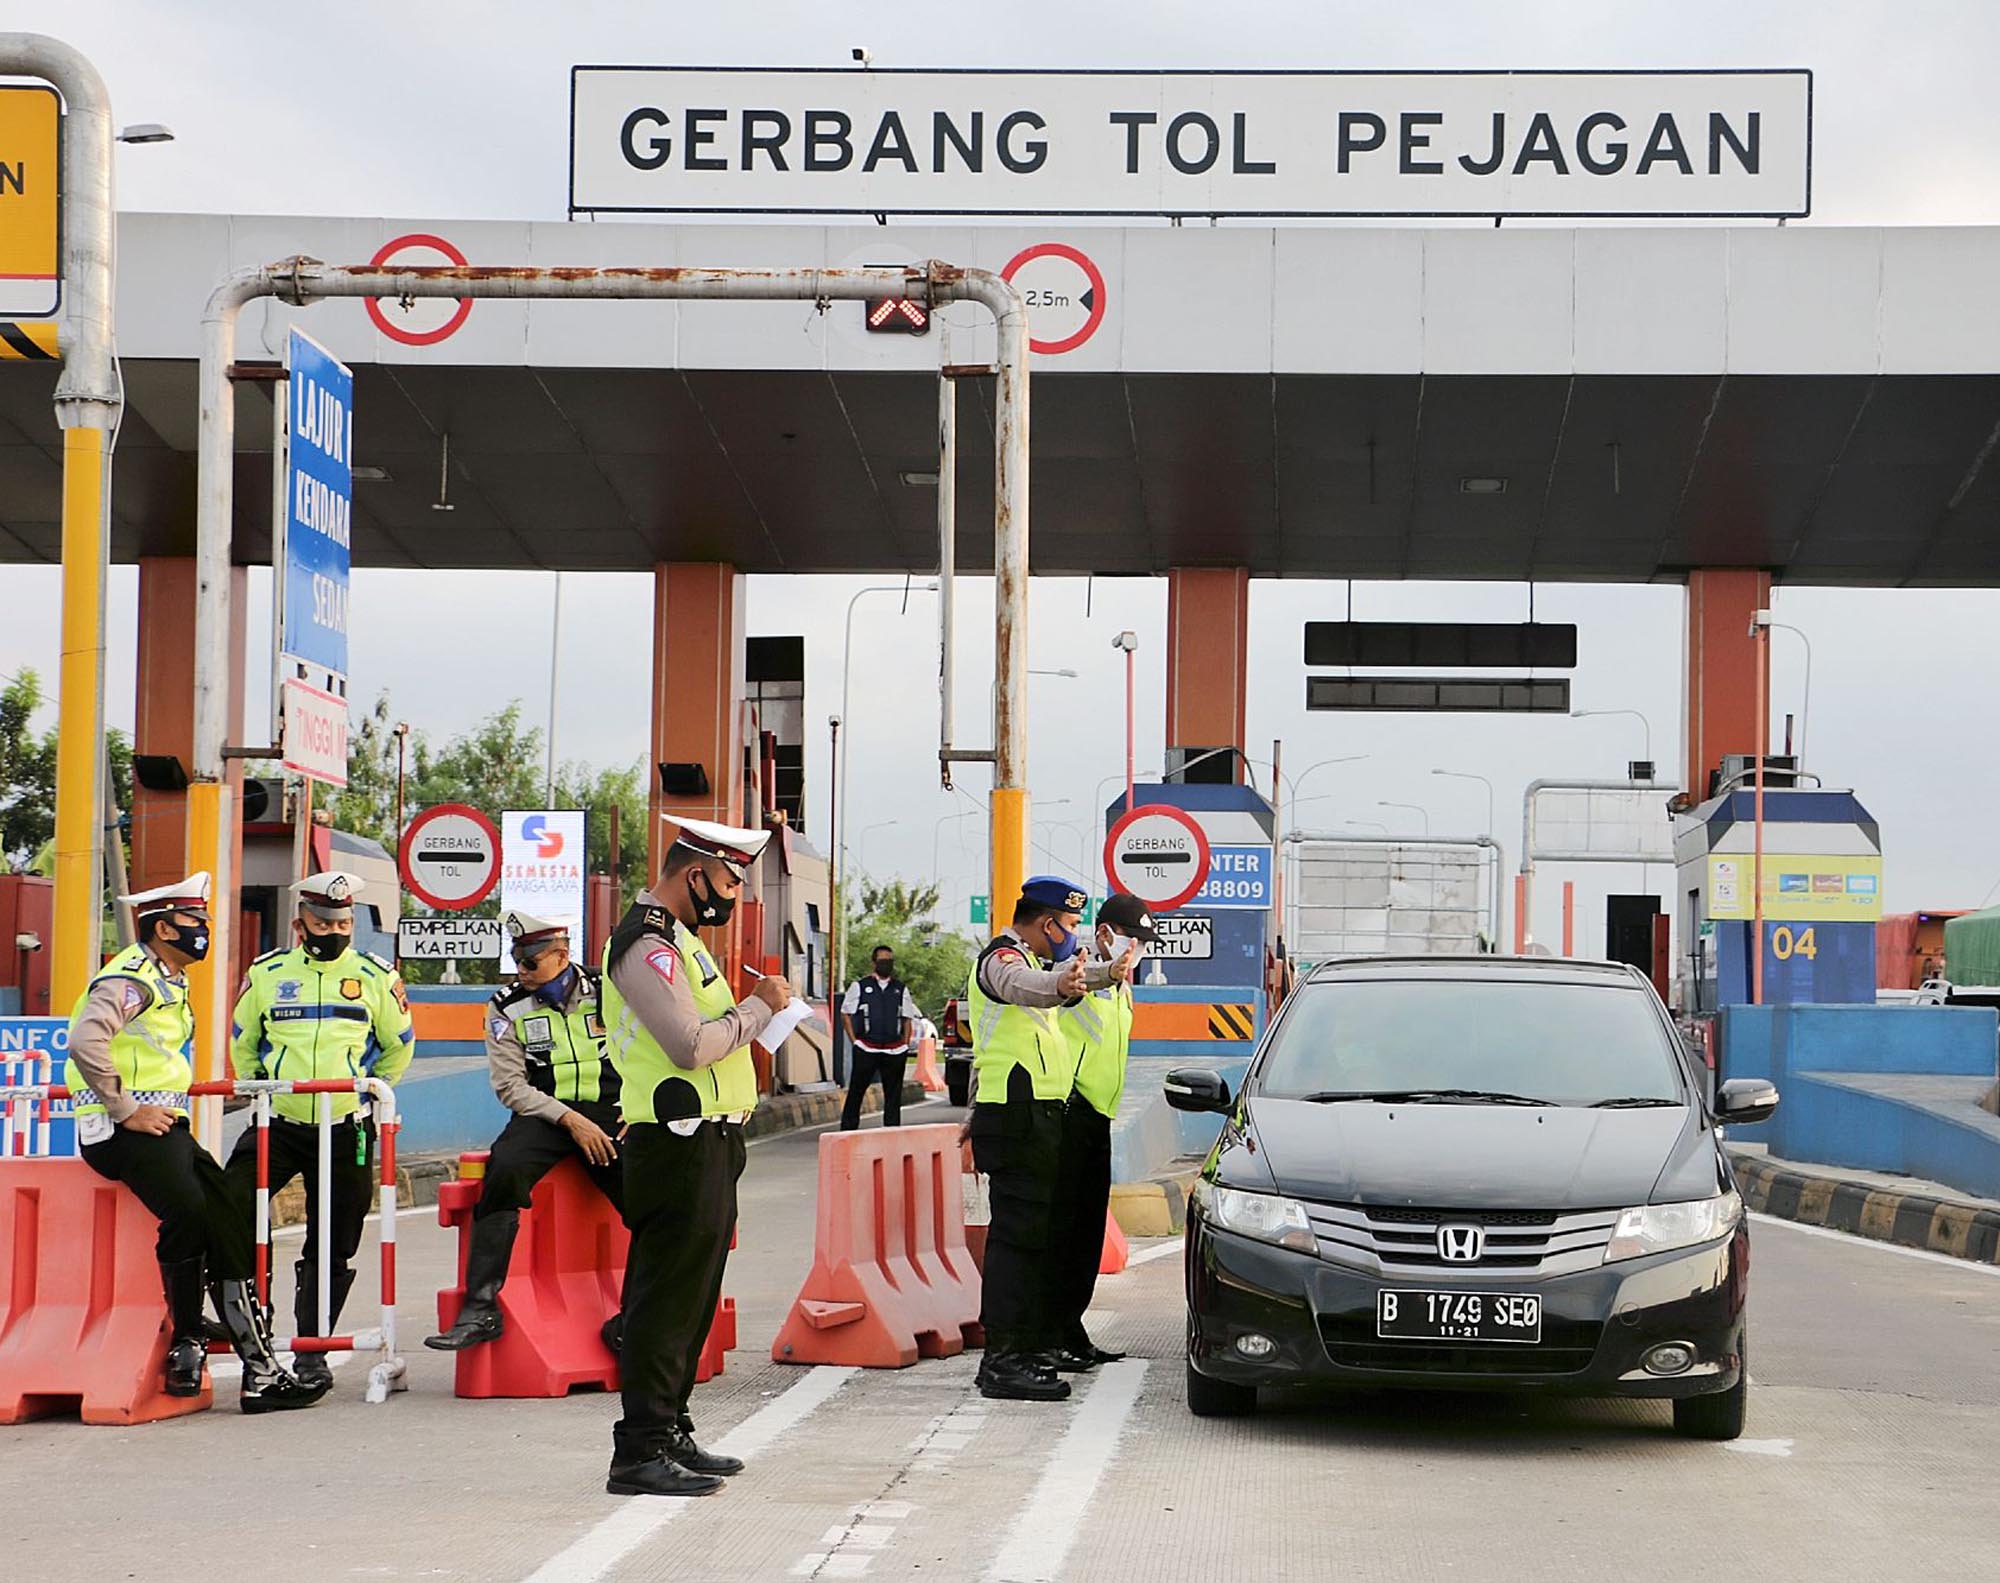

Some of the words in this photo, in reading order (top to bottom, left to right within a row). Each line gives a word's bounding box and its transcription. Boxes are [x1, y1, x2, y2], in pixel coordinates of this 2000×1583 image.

[620, 107, 1048, 174] GERBANG
[1109, 111, 1276, 175] TOL
[1336, 111, 1761, 175] PEJAGAN
[1025, 290, 1069, 308] 2,5m
[297, 371, 343, 463] LAJUR
[296, 706, 333, 757] TINGGI
[424, 837, 481, 849] GERBANG
[1127, 838, 1185, 850] GERBANG
[440, 865, 461, 877] TOL
[505, 865, 578, 878] SEMESTA
[1145, 866, 1168, 878] TOL
[401, 921, 500, 936] TEMPELKAN
[415, 941, 482, 955] KARTU
[1772, 926, 1817, 960] 04
[1383, 1293, 1398, 1321] B
[1426, 1294, 1481, 1323] 1749
